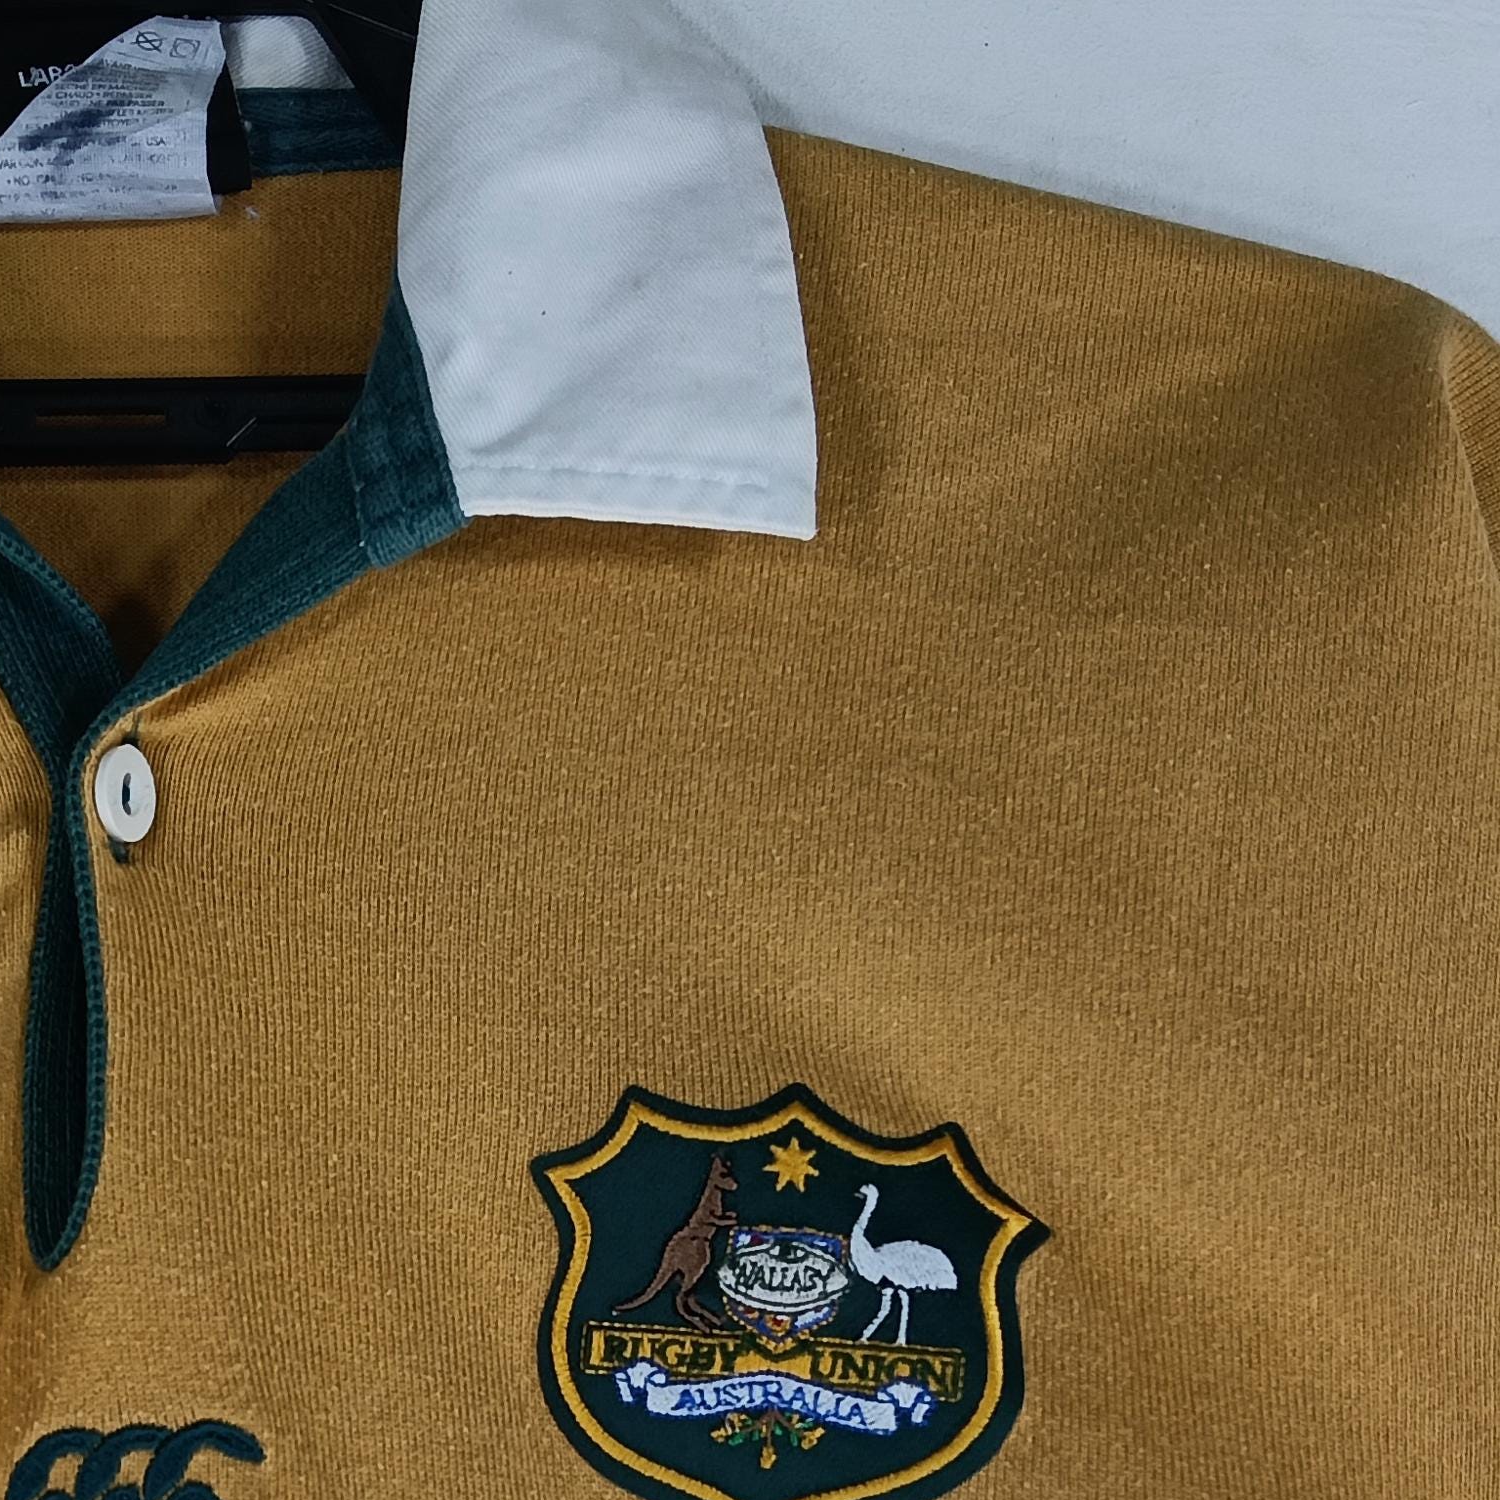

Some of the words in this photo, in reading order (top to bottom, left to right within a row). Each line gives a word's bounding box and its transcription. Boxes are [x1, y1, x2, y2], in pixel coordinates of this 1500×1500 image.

[604, 1334, 739, 1374] RUGBY
[810, 1348, 950, 1400] UNION
[677, 1380, 867, 1425] AUSTRALIA
